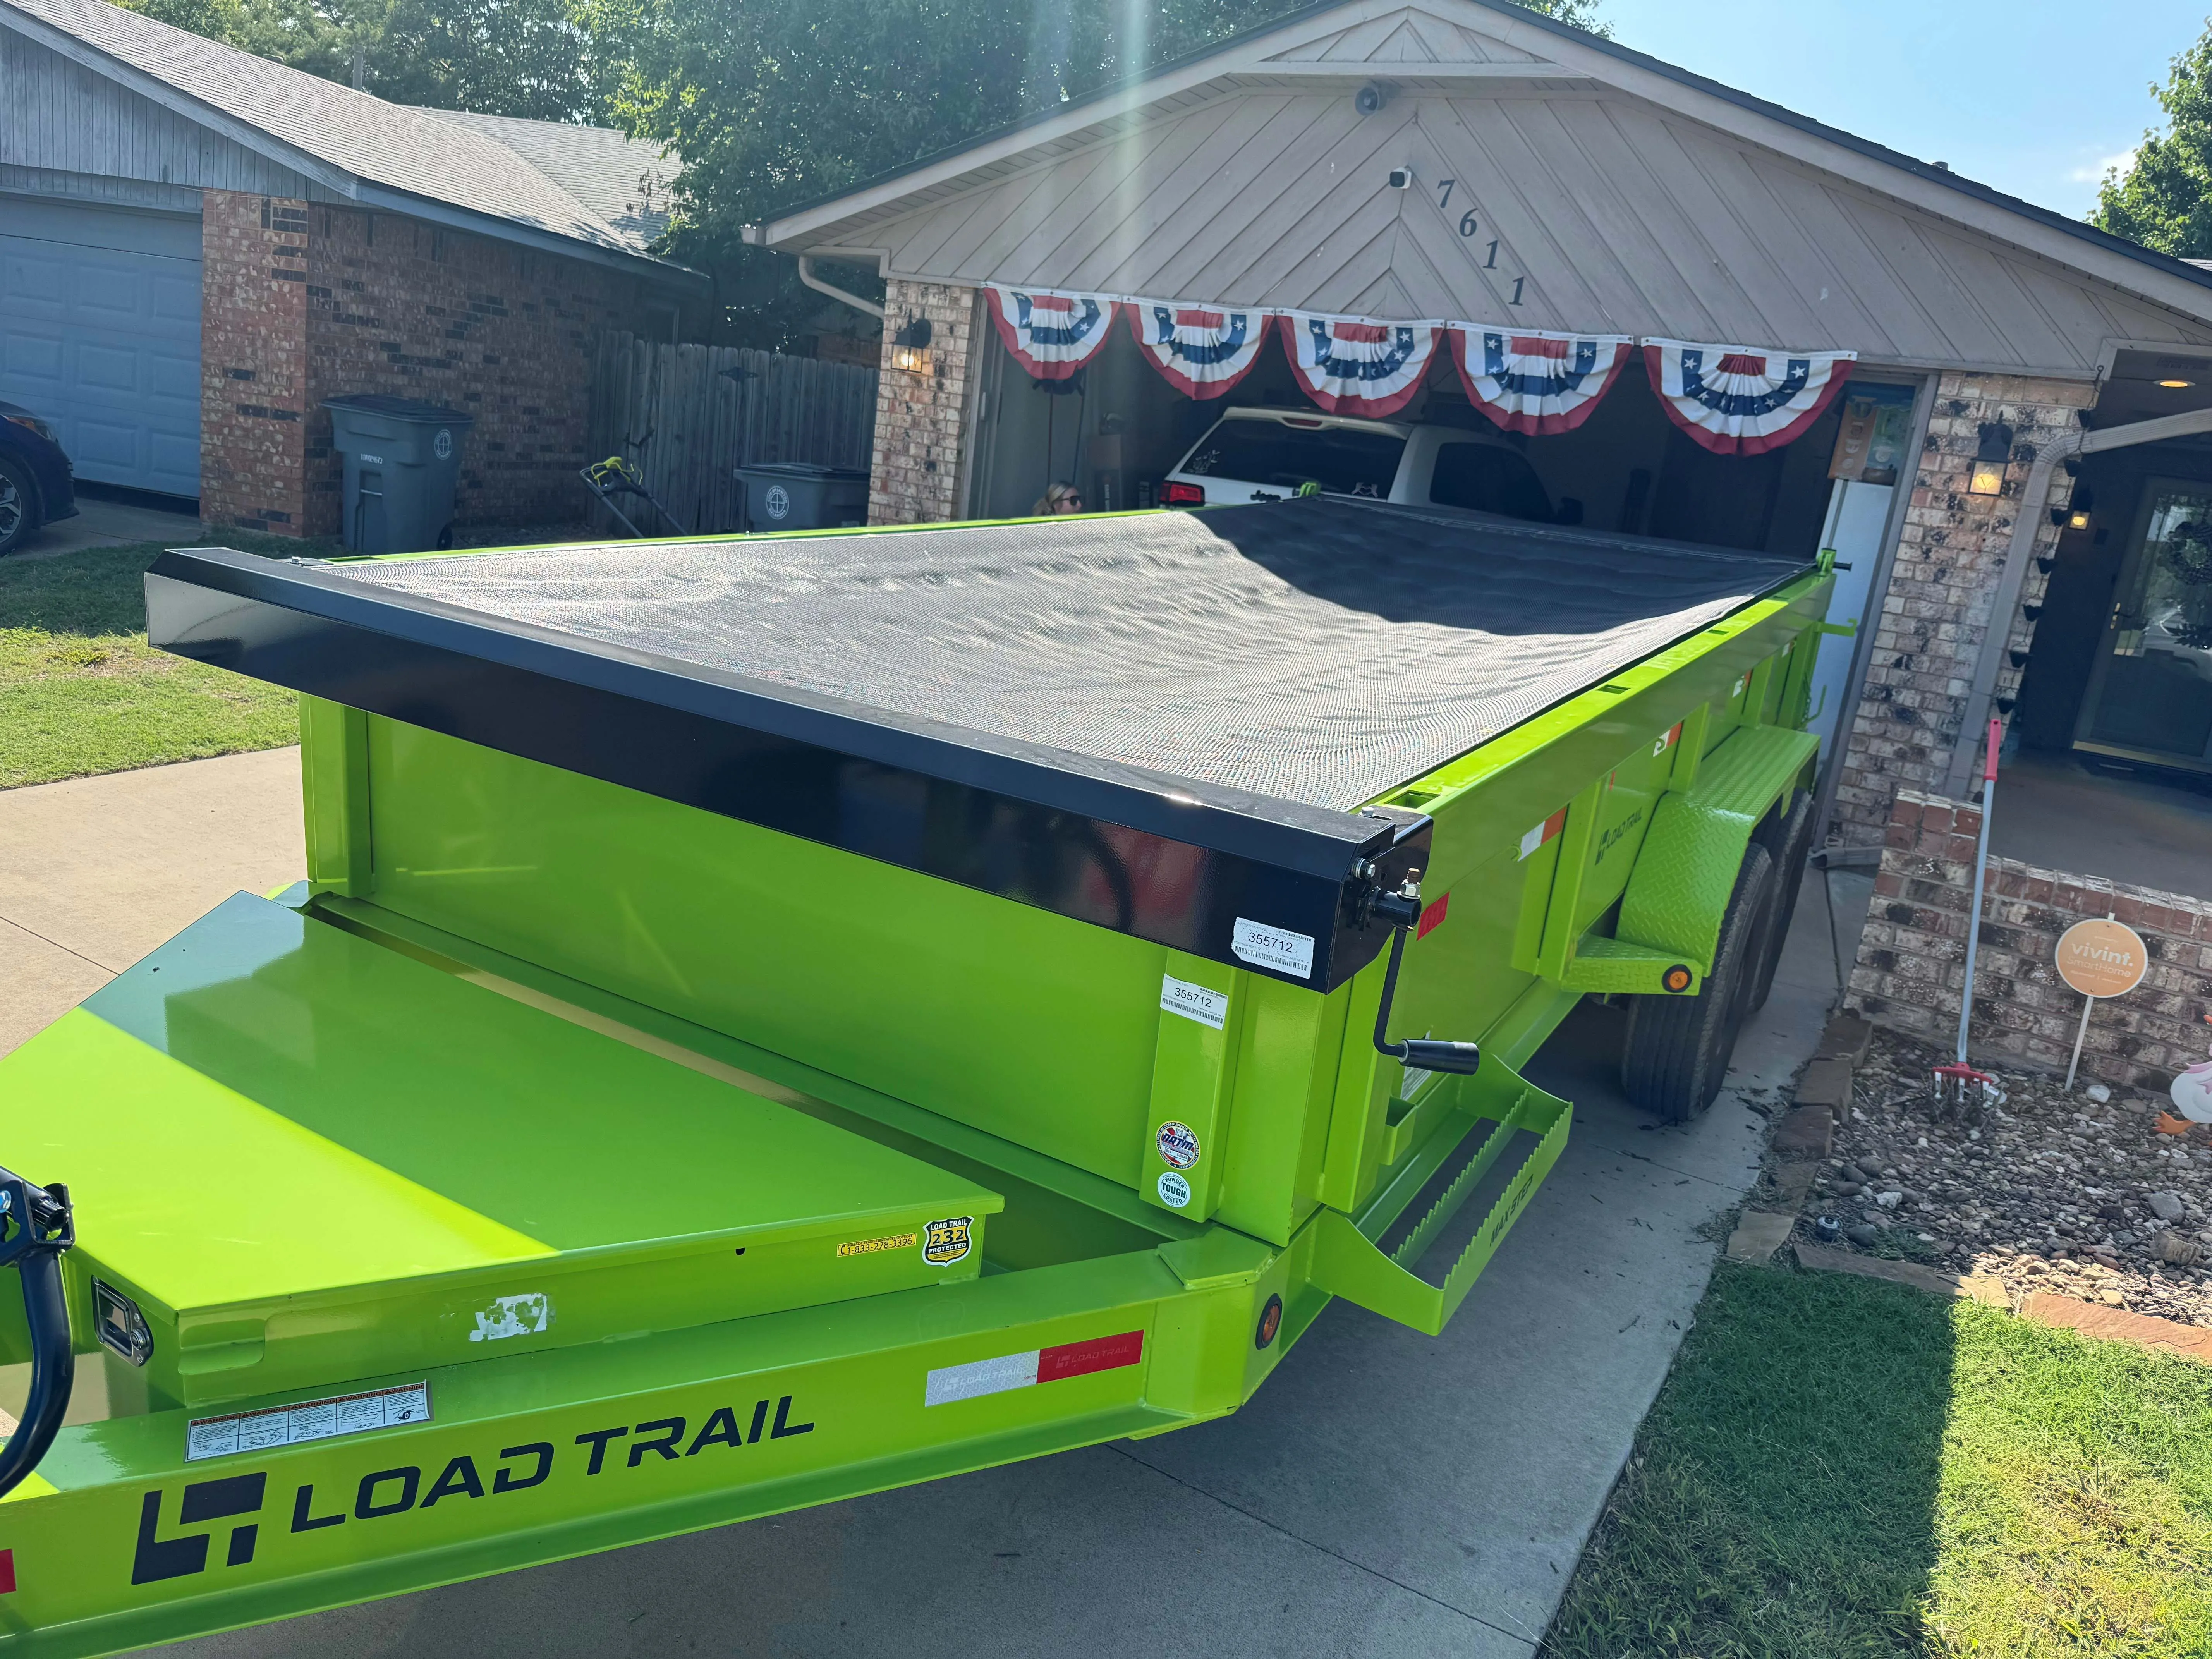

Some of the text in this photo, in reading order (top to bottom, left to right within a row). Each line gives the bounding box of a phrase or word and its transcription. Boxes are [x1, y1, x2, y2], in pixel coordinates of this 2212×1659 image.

[1437, 179, 1524, 306] 7611
[1249, 932, 1292, 953] 355712
[1175, 988, 1211, 1008] 355712
[1165, 1177, 1184, 1188] POWDER
[1162, 1182, 1186, 1199] TOUGH
[1510, 1174, 1534, 1216] STEP
[1164, 1193, 1182, 1204] COATED
[930, 1219, 967, 1231] LOAD TRAIL
[933, 1230, 964, 1244] 232
[847, 1238, 912, 1255] 1-833-278-3396
[929, 1242, 966, 1254] PROTECTED
[1072, 1352, 1099, 1363] LOAD
[1102, 1346, 1129, 1356] TRAIL
[298, 1399, 336, 1408] WARNING
[345, 1392, 381, 1401] WARNING
[248, 1407, 287, 1417] WARNING
[198, 1415, 238, 1425] WARNING
[290, 1395, 815, 1534] LOAD TRAIL
